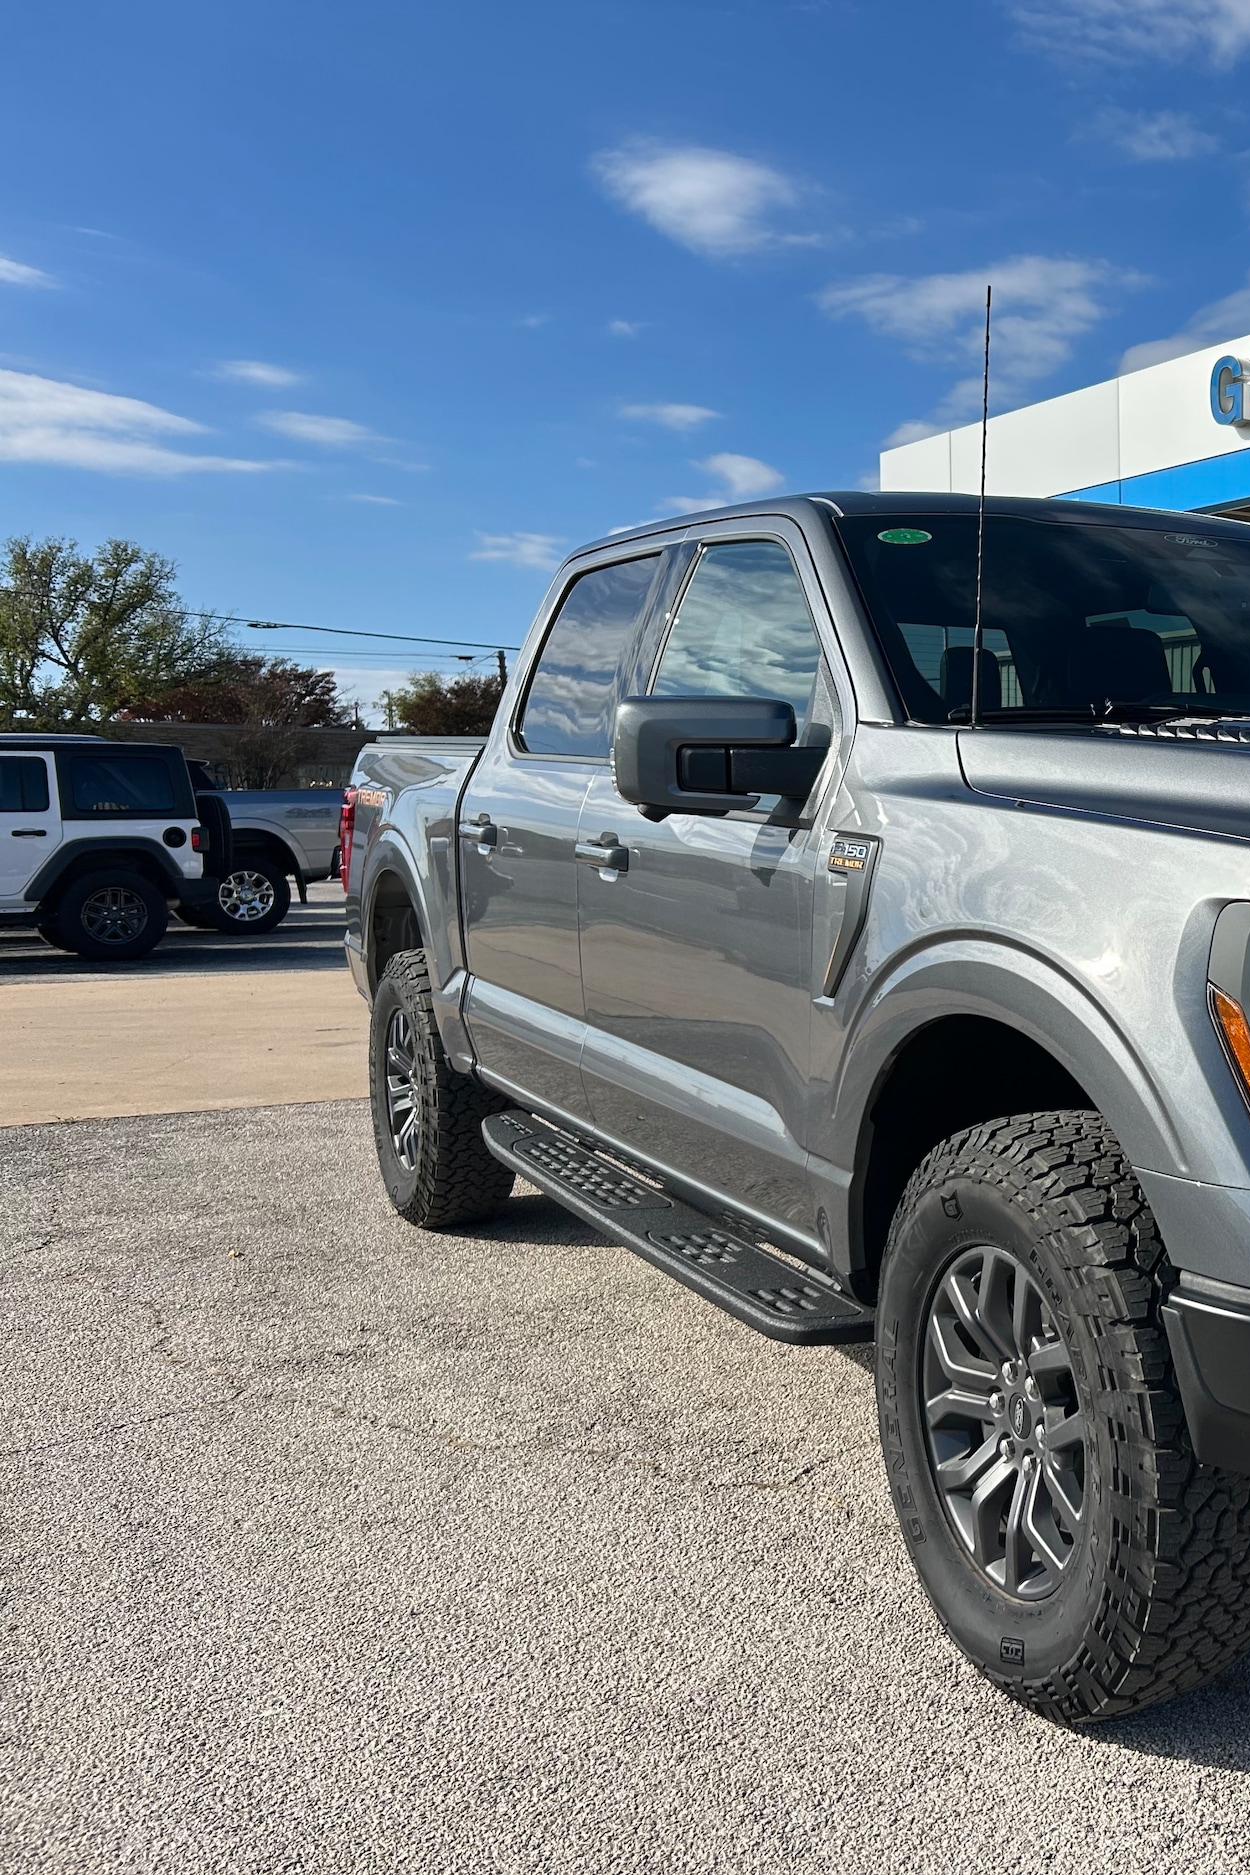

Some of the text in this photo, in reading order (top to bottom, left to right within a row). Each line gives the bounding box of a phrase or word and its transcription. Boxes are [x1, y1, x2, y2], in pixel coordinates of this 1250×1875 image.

[358, 788, 387, 807] TREMOR
[830, 857, 864, 869] TREMOR
[881, 1318, 927, 1545] GENERAL
